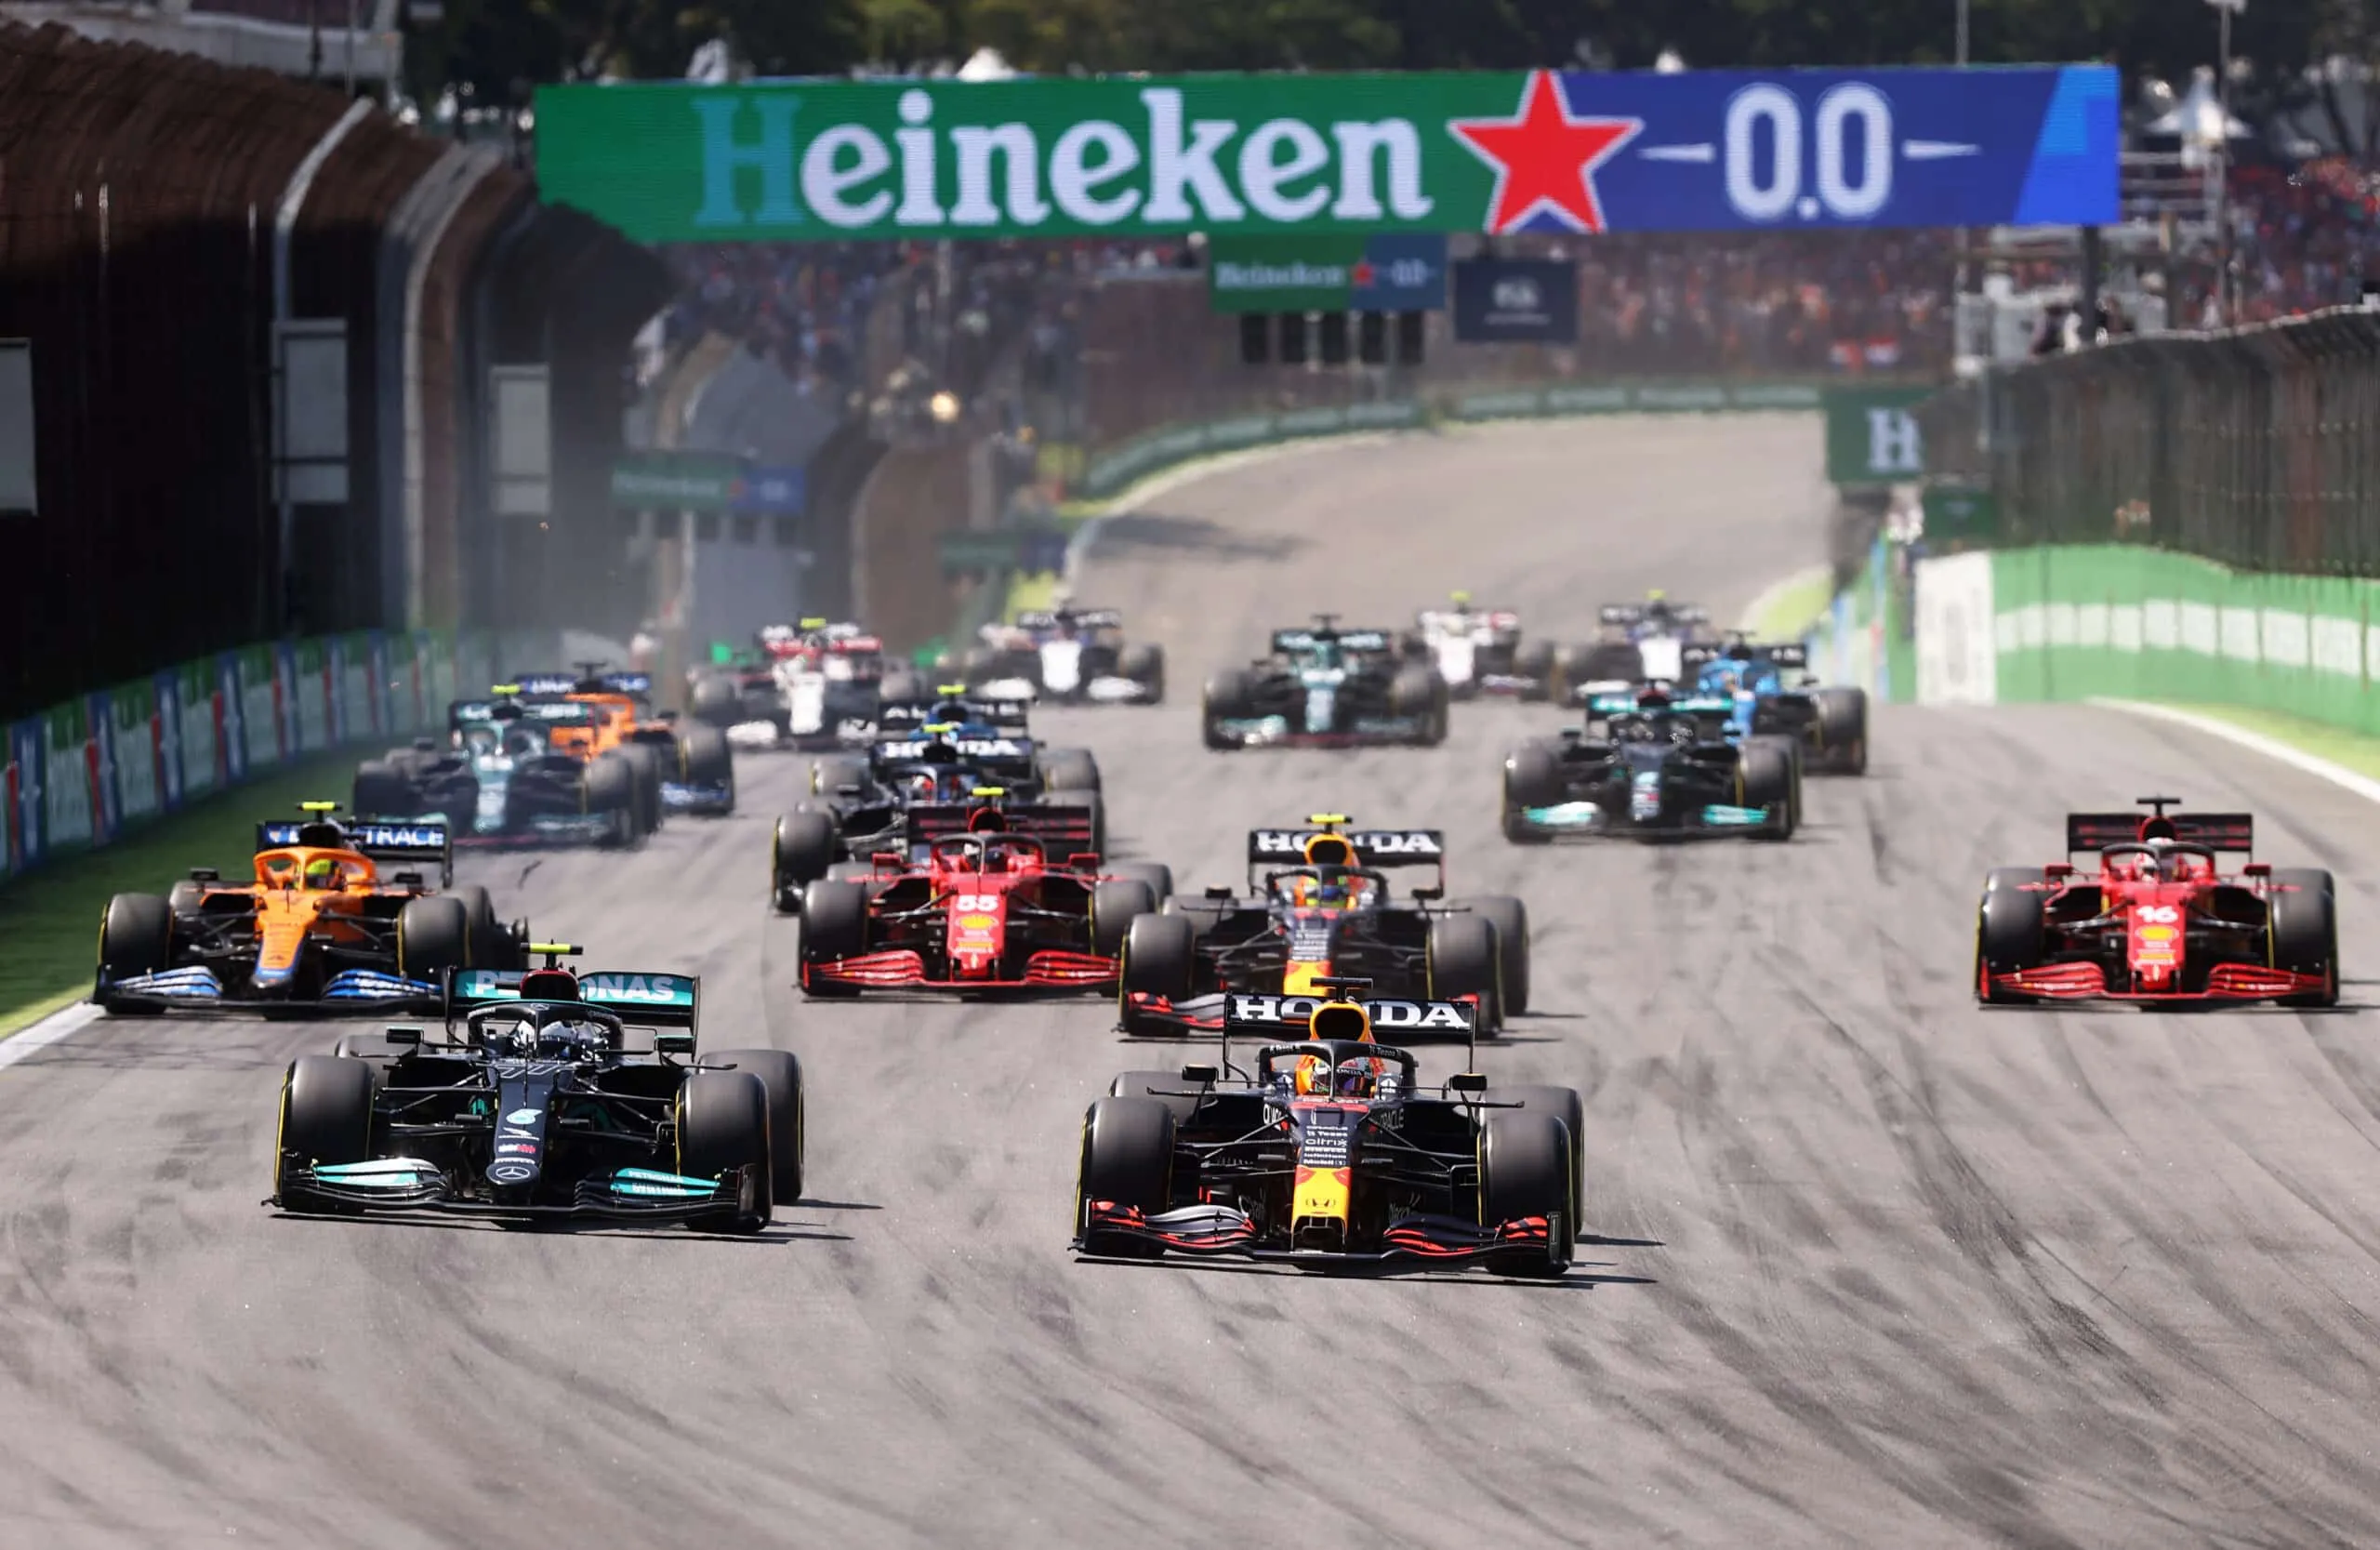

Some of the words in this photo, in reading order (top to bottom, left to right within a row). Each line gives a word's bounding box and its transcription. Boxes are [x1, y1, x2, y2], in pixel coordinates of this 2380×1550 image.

[693, 88, 1433, 228] Heineken
[1726, 83, 1893, 221] 0.0
[1257, 831, 1441, 853] HDA
[956, 894, 998, 912] 55
[2135, 906, 2178, 923] 16
[475, 970, 674, 1000] PEONAS
[1232, 996, 1470, 1027] HODA
